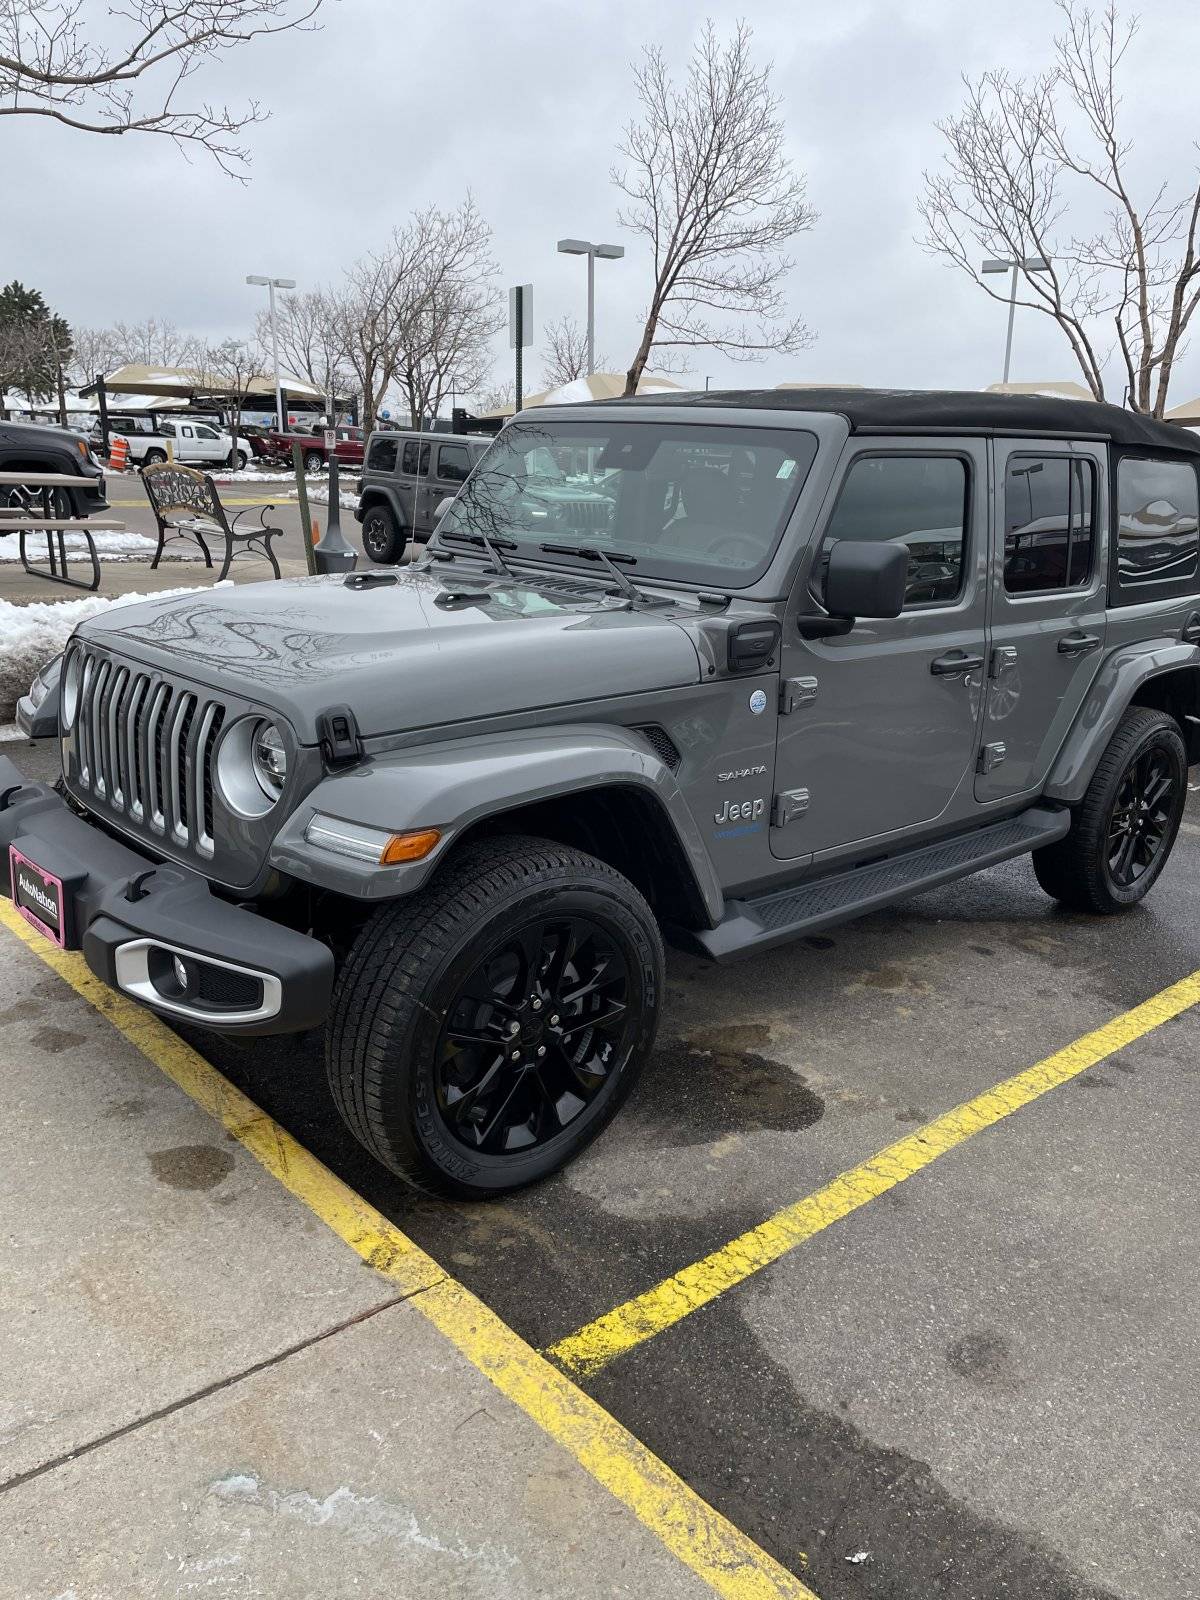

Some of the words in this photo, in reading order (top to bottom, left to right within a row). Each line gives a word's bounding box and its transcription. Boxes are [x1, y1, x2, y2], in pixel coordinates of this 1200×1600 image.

[717, 765, 767, 782] SAHARA
[714, 798, 764, 824] Jeep
[19, 873, 58, 915] AutoNation
